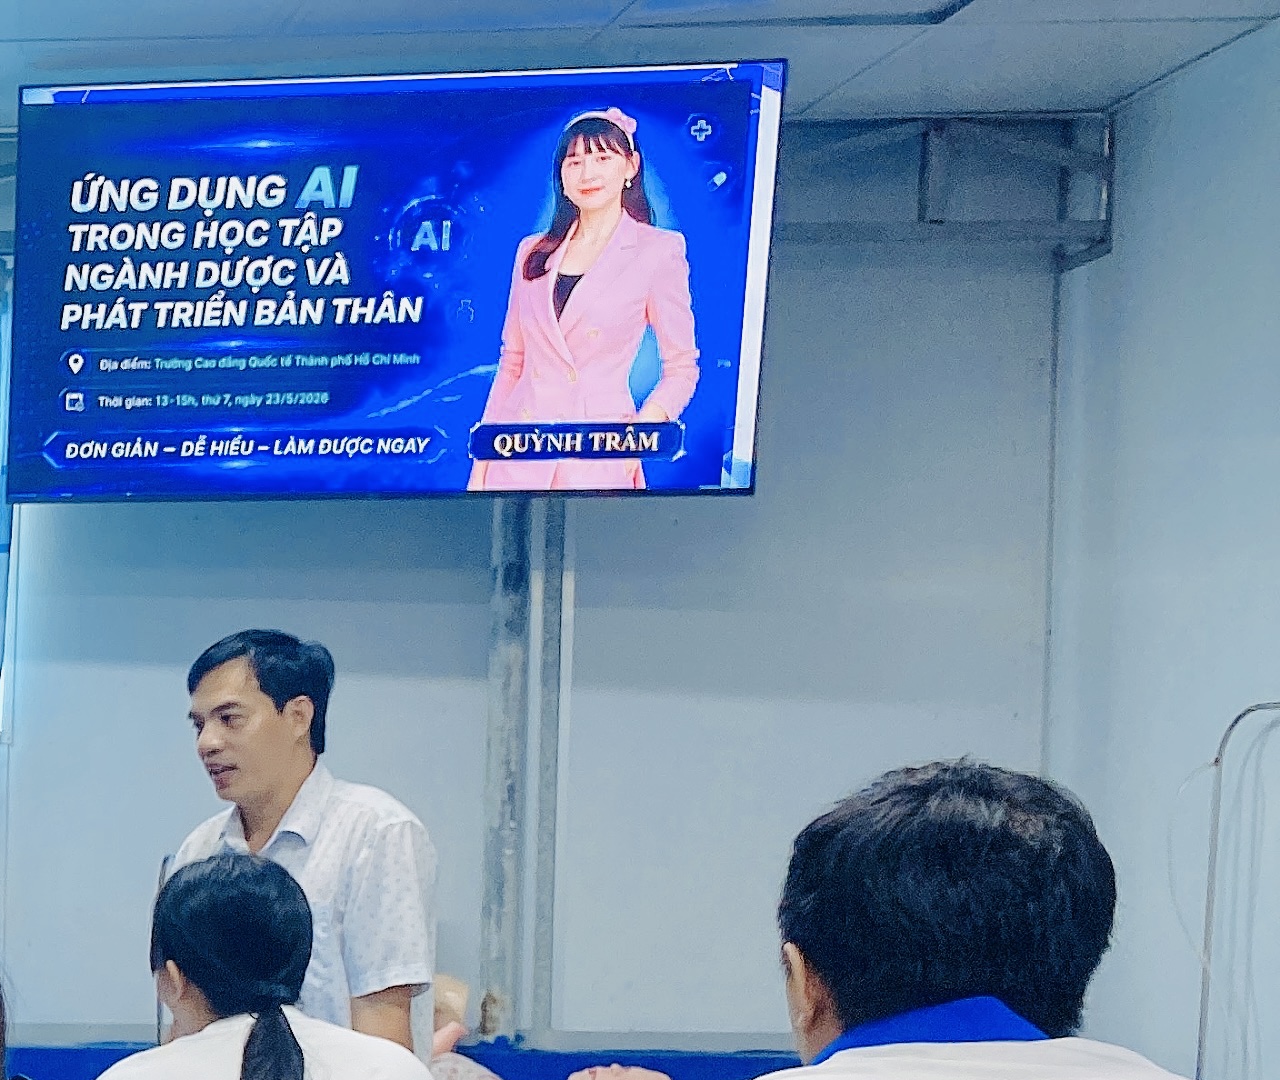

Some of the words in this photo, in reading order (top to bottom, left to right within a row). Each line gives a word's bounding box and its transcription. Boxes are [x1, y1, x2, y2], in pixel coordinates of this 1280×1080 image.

[70, 173, 159, 213] ỨNG
[167, 175, 287, 217] DỤNG
[294, 164, 360, 210] AI
[68, 220, 186, 252] TRONG
[193, 217, 270, 255] HỌC
[278, 211, 342, 253] TẬP
[411, 219, 452, 252] AI
[64, 257, 189, 292] NGÀNH
[195, 255, 297, 294] DƯỢC
[305, 252, 351, 286] VÀ
[60, 297, 149, 330] PHÁT
[154, 290, 247, 328] TRIỂN
[254, 293, 322, 326] BẢN
[331, 290, 424, 324] THÂN
[195, 357, 216, 369] Cao
[65, 441, 108, 459] ĐƠN
[111, 438, 158, 458] GIẢN
[273, 436, 315, 455] LÀM
[318, 436, 374, 458] ĐƯỢC
[377, 437, 431, 455] NGAY
[494, 428, 583, 457] QUỲNH
[589, 425, 659, 452] TRÂM
